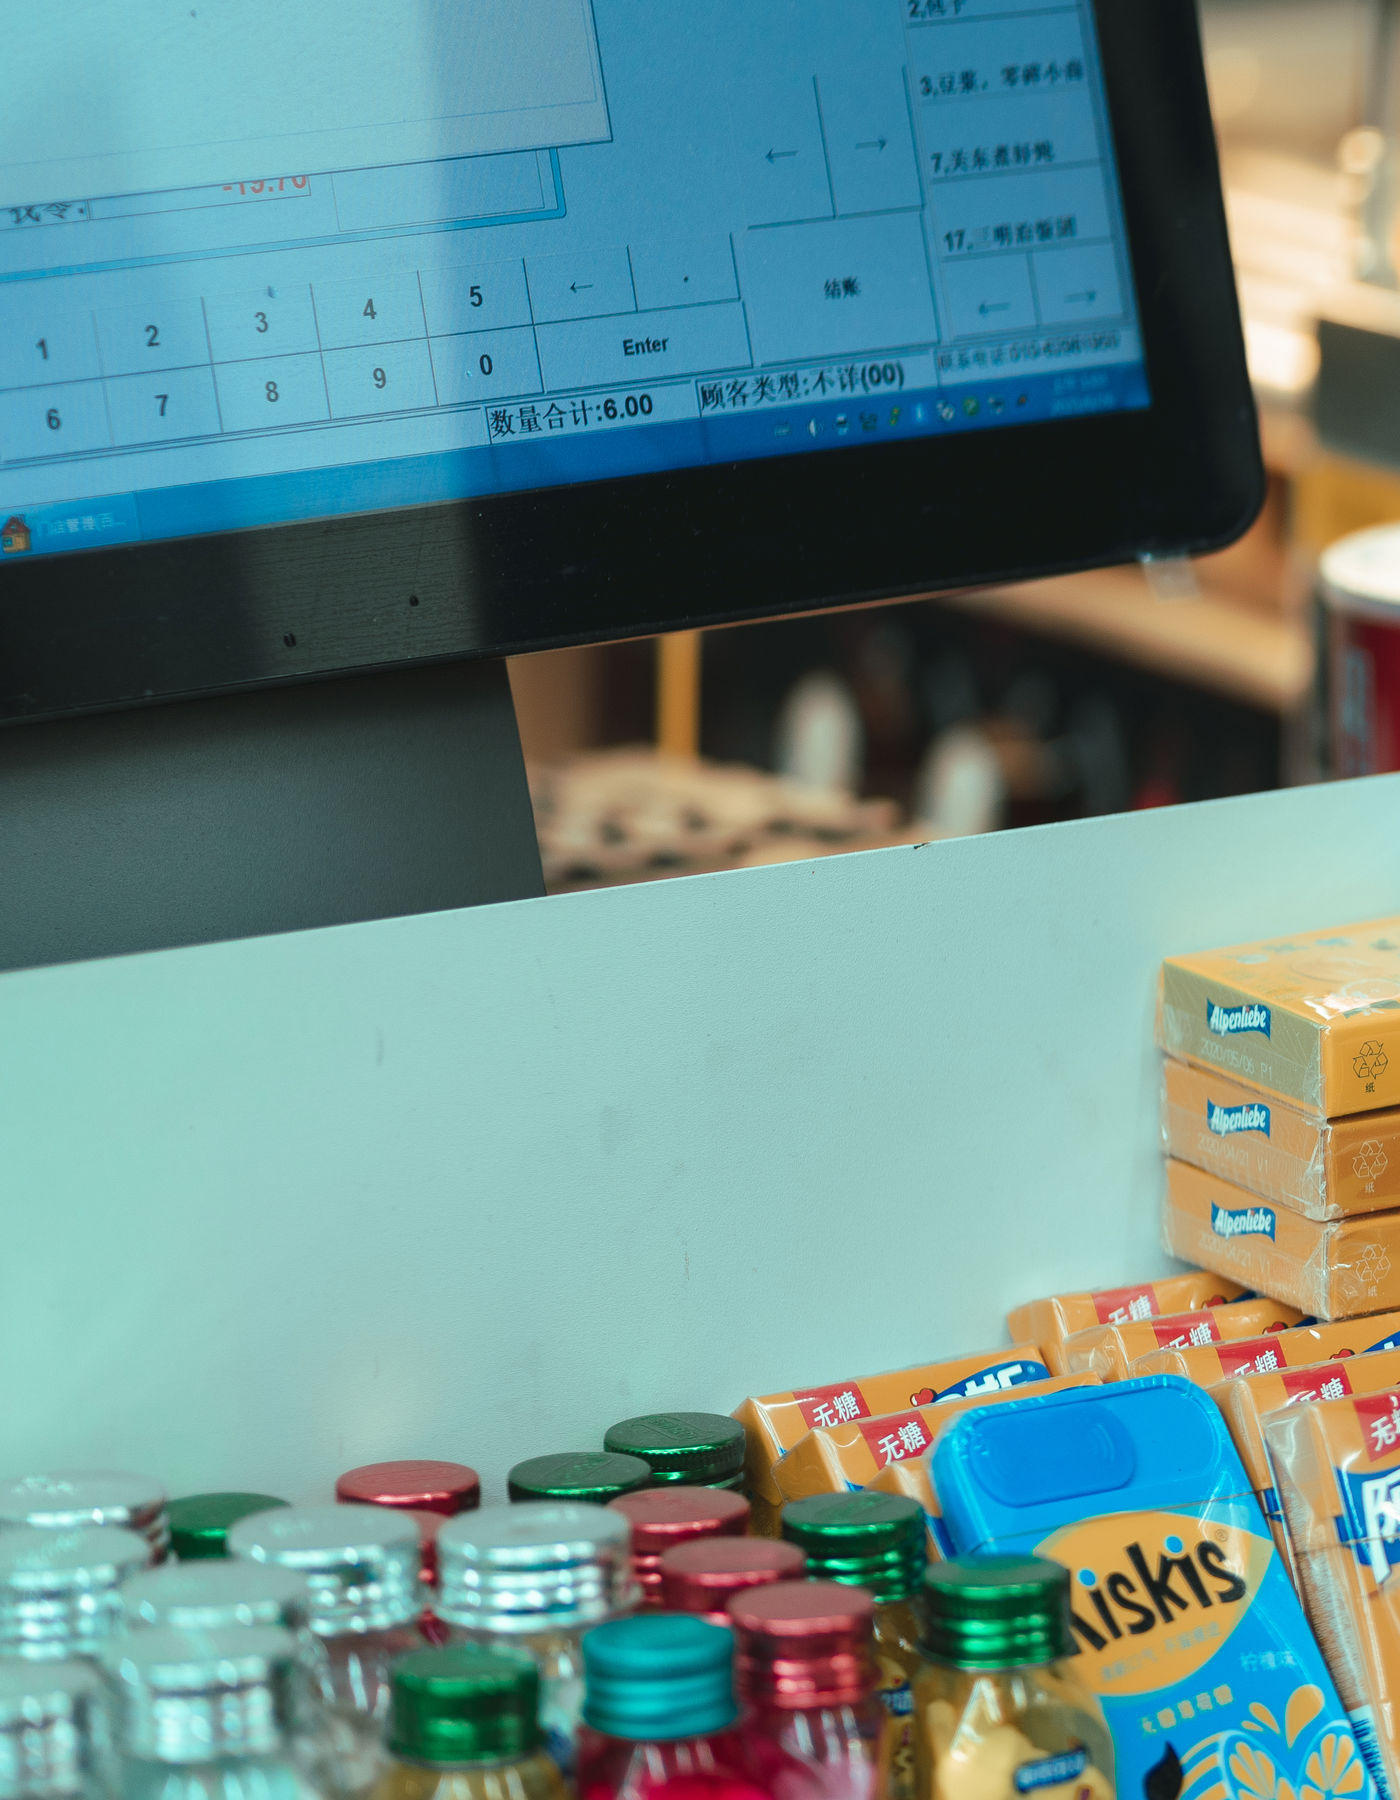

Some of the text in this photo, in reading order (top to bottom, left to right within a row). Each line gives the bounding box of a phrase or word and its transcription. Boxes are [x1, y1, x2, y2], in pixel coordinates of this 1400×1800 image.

[469, 285, 484, 307] 5
[823, 276, 860, 300] 结账
[362, 298, 377, 319] 4
[255, 311, 269, 333] 3
[145, 324, 160, 347] 2
[622, 335, 670, 356] Enter
[36, 338, 49, 360] 1
[479, 353, 493, 375] 0
[372, 367, 387, 389] 9
[265, 381, 279, 402] 8
[154, 394, 169, 417] 7
[490, 393, 654, 439] 数量合计:6.00
[46, 408, 61, 430] 6
[1210, 1004, 1267, 1037] Alpenliebe
[1365, 1082, 1375, 1093] 纸
[1211, 1104, 1266, 1138] Alpenliebe
[1214, 1208, 1272, 1240] Alpenliebe
[877, 1421, 927, 1465] 无糖
